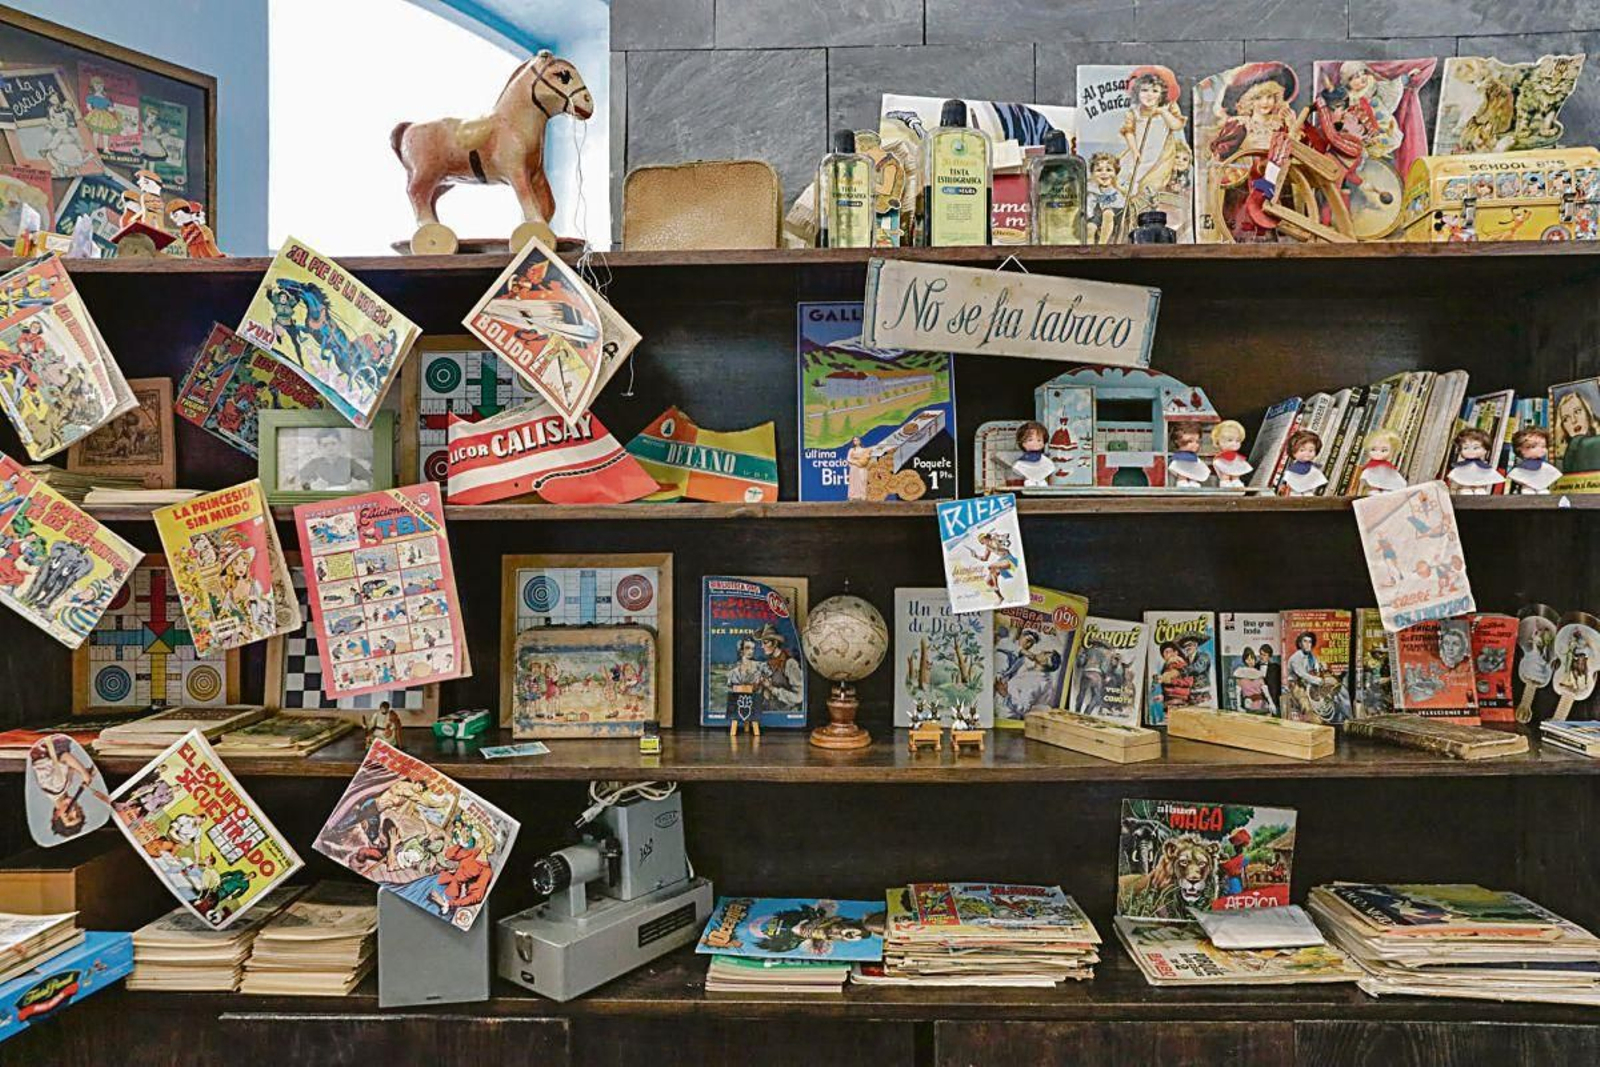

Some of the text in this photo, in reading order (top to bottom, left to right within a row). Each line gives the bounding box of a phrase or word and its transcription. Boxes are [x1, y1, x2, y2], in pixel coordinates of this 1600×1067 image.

[17, 79, 33, 92] la
[1082, 76, 1134, 104] Al pasar
[1085, 97, 1132, 120] la barca
[949, 167, 970, 176] TINTA
[1468, 163, 1528, 171] SCHOOL
[308, 256, 331, 280] PIE
[327, 271, 344, 291] DE
[882, 277, 950, 329] No
[946, 306, 981, 335] se
[1025, 293, 1137, 348] tabaco
[245, 320, 277, 345] YUKI
[476, 314, 534, 366] BOLIDO
[491, 414, 595, 458] CALISAY
[805, 448, 837, 460] última
[913, 456, 952, 471] Paquete
[928, 470, 940, 490] 1
[171, 485, 255, 522] LA PRINCESITA
[184, 501, 251, 531] SIN MIEDO
[908, 600, 932, 616] Un
[1154, 613, 1209, 646] COYOTE
[177, 742, 250, 821] EL EQUIPO
[175, 767, 276, 878] SECUESTRADO
[1157, 804, 1197, 816] album
[1169, 807, 1224, 832] MAGA
